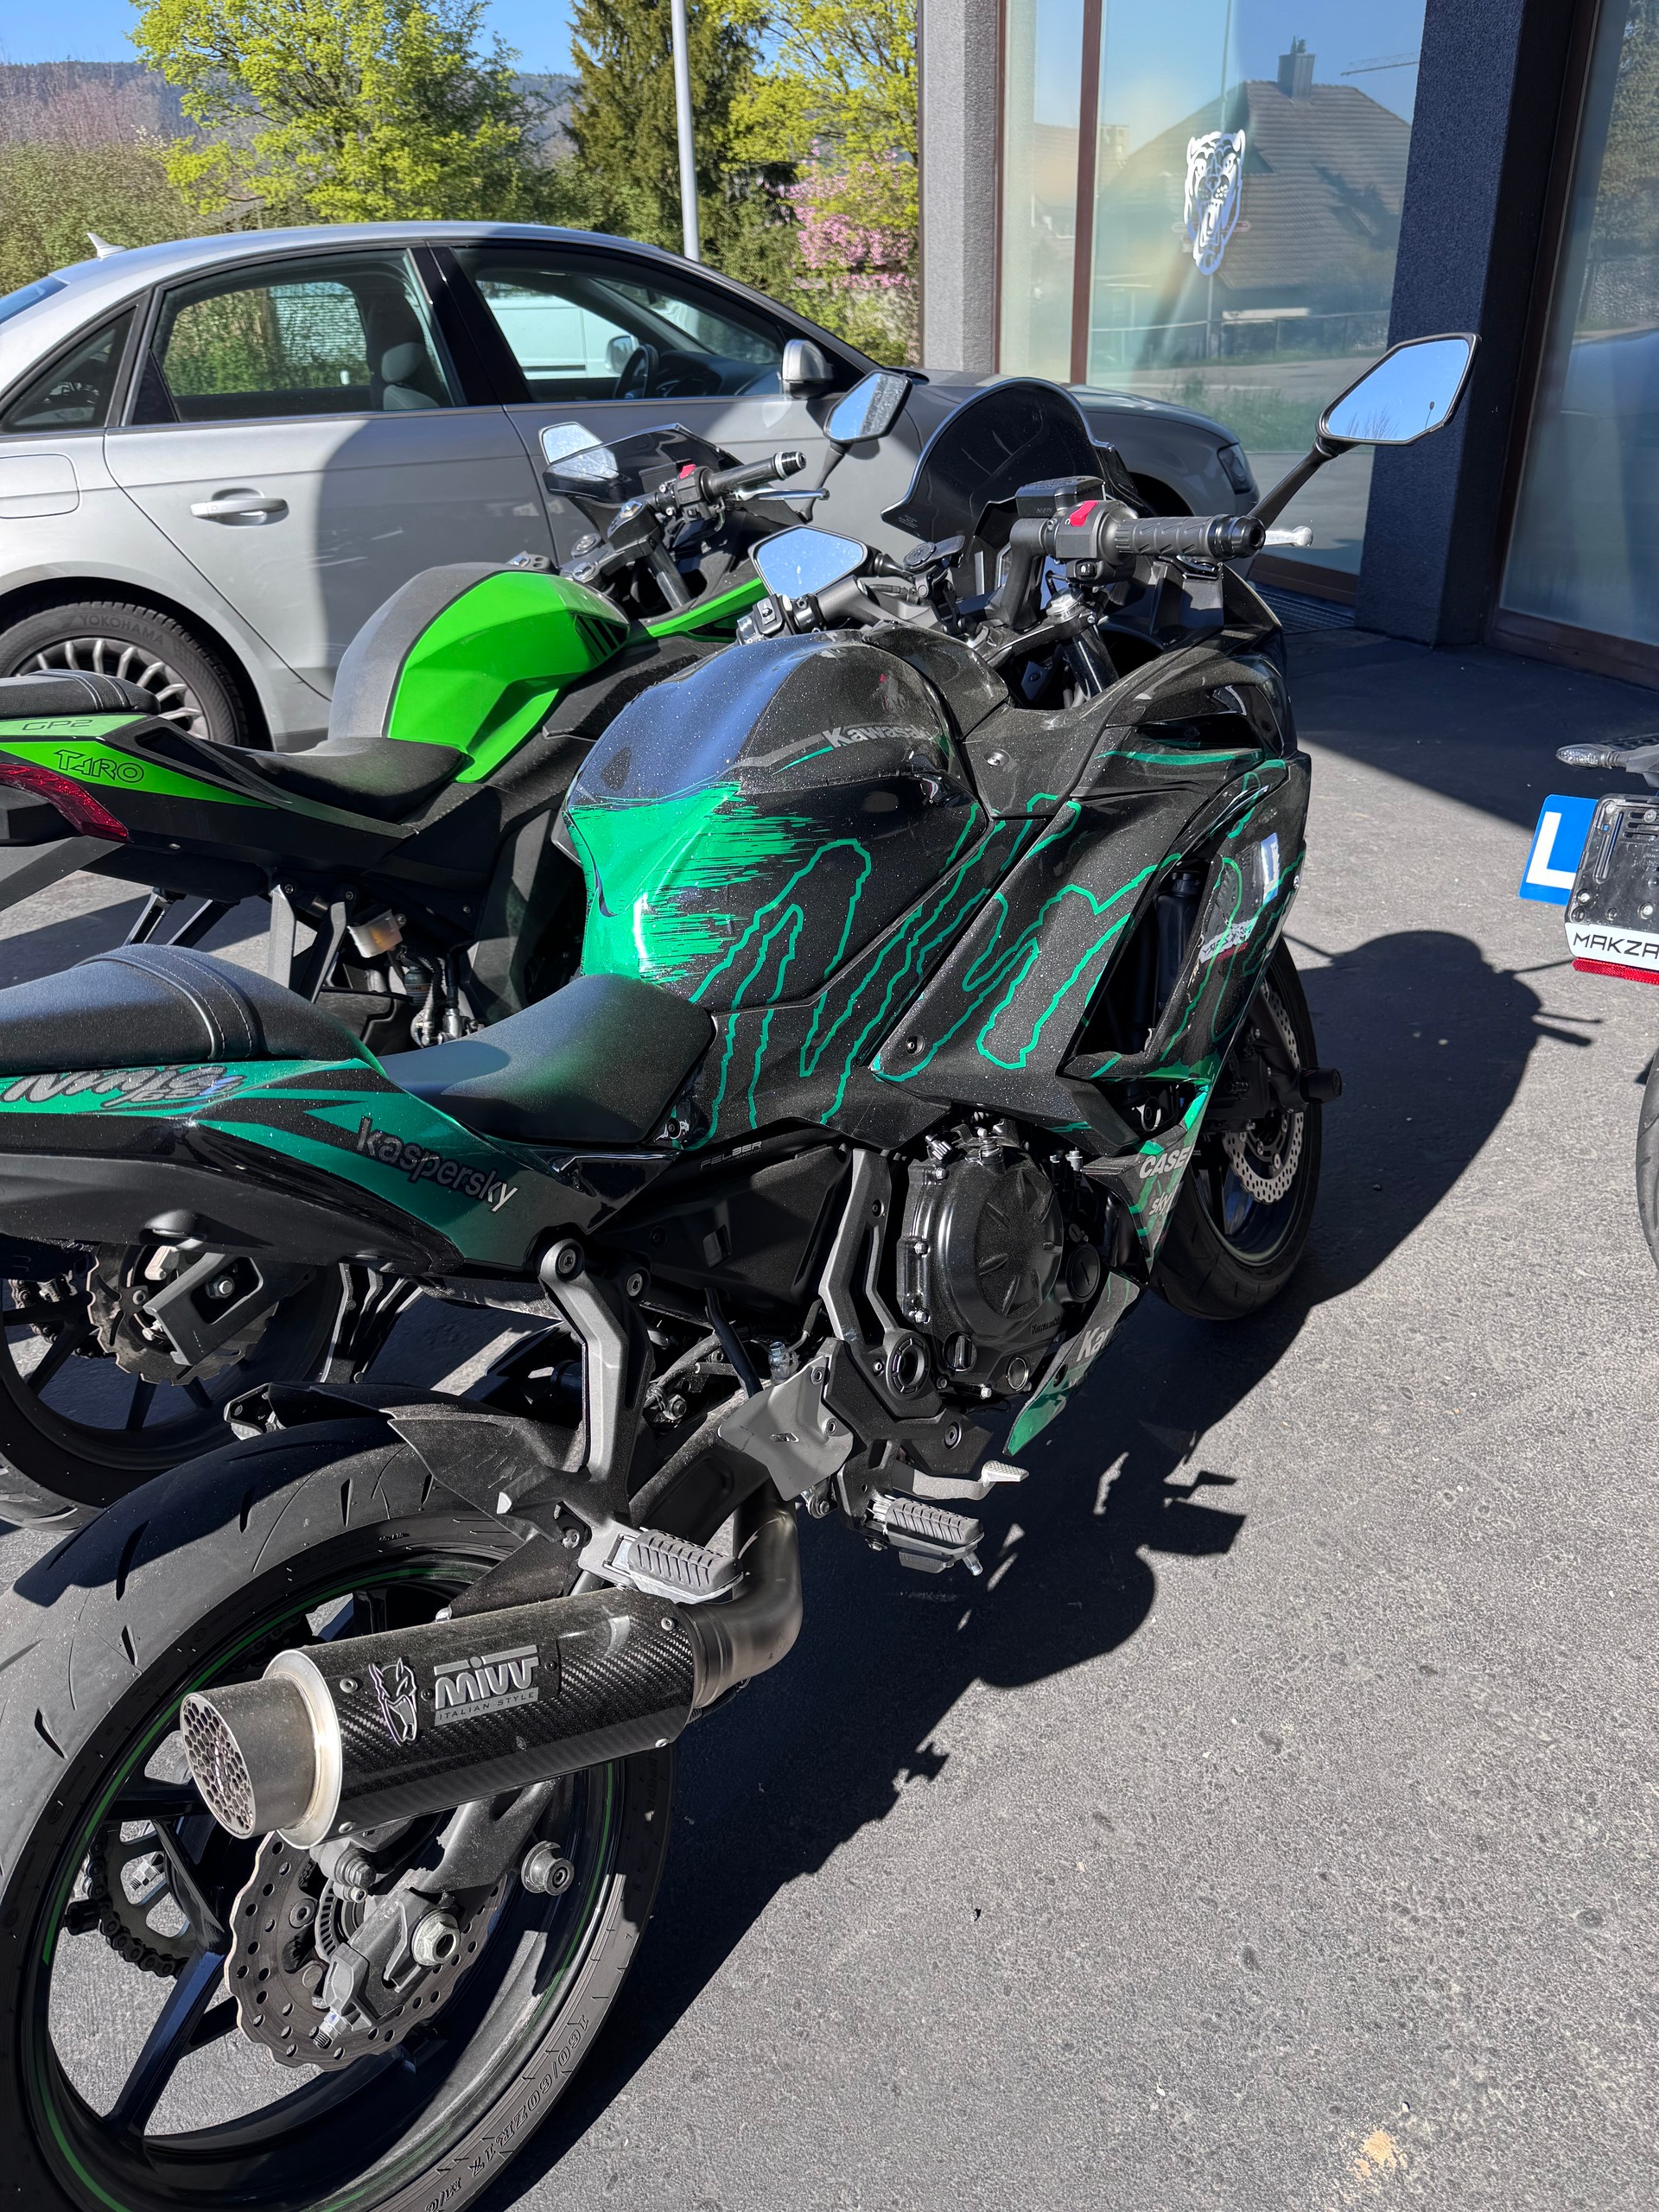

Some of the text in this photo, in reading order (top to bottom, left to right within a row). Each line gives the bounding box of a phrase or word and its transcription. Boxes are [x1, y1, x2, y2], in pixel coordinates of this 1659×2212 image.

[79, 614, 163, 645] YOKOHAMA
[22, 719, 94, 731] GP2
[823, 724, 933, 748] Kawasaki
[1526, 810, 1576, 890] L
[1573, 931, 1659, 959] MAKZA
[355, 1116, 518, 1213] kaspersky
[699, 1141, 762, 1171] FELBER
[1139, 1146, 1192, 1179] CASE
[438, 1691, 536, 1721] ITALIAN STYLE
